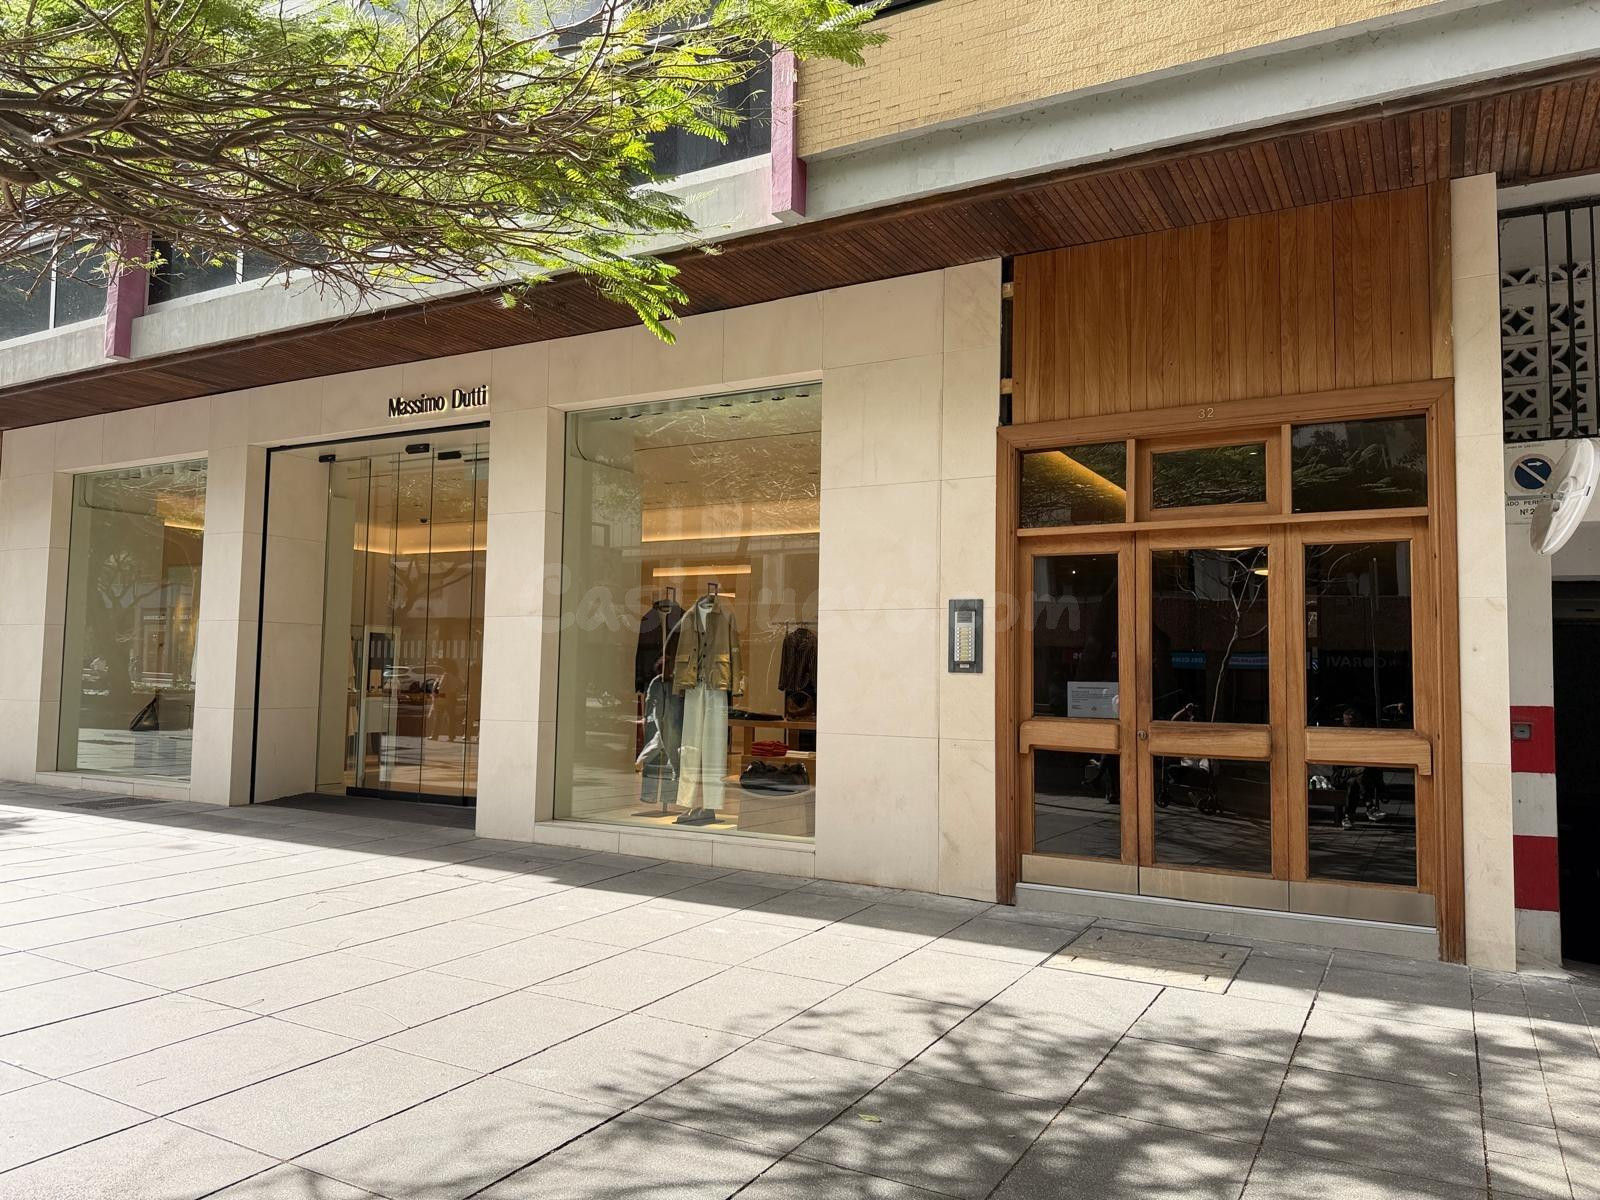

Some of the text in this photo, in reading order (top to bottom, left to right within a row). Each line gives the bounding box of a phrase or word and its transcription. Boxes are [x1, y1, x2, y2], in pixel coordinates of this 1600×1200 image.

[388, 384, 488, 418] Massimo Dutti
[1198, 407, 1214, 419] 32
